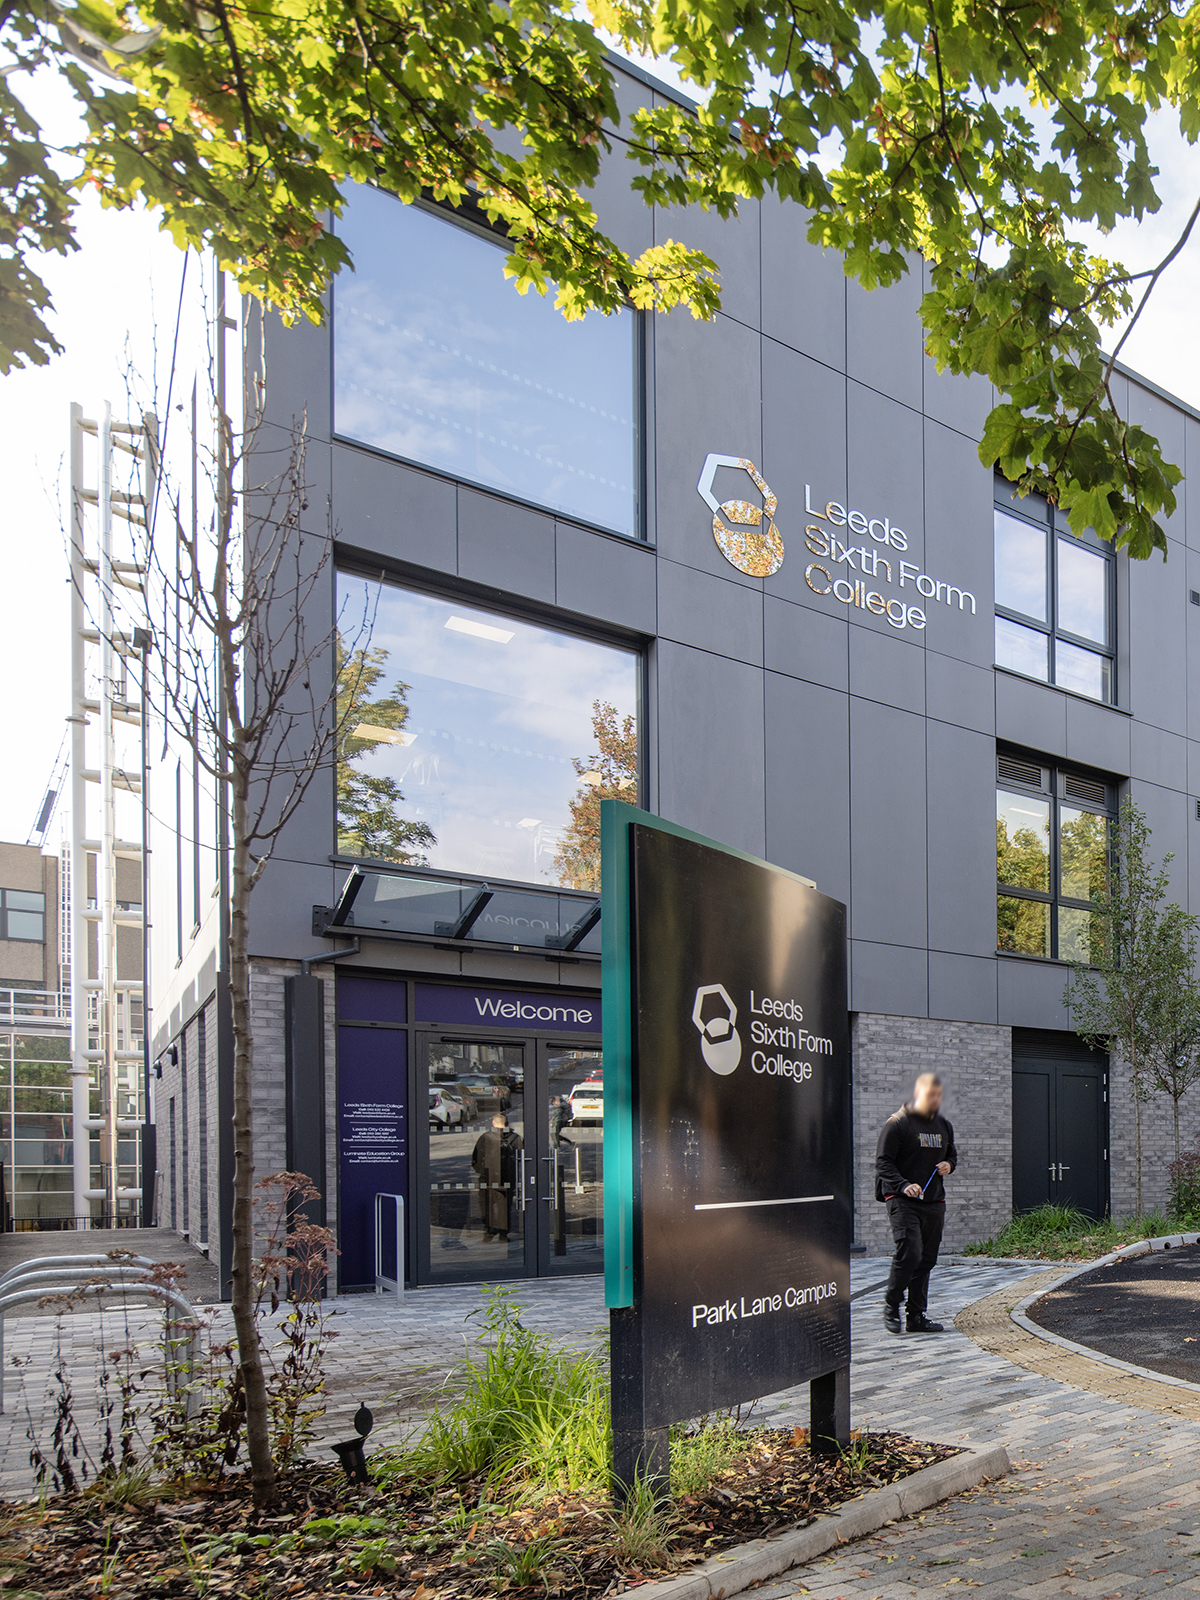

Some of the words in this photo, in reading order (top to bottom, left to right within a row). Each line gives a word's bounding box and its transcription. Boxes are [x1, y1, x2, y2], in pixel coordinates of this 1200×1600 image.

[804, 483, 908, 551] Leeds
[804, 524, 892, 583] Sixth
[899, 560, 976, 615] Form
[804, 563, 927, 630] College
[474, 997, 593, 1024] Welcome
[750, 990, 803, 1022] Leeds
[751, 1020, 796, 1049] Sixth
[798, 1028, 833, 1056] Form
[751, 1051, 813, 1083] College
[692, 1299, 738, 1328] Park
[740, 1297, 782, 1318] Lane
[784, 1281, 837, 1308] Campus
